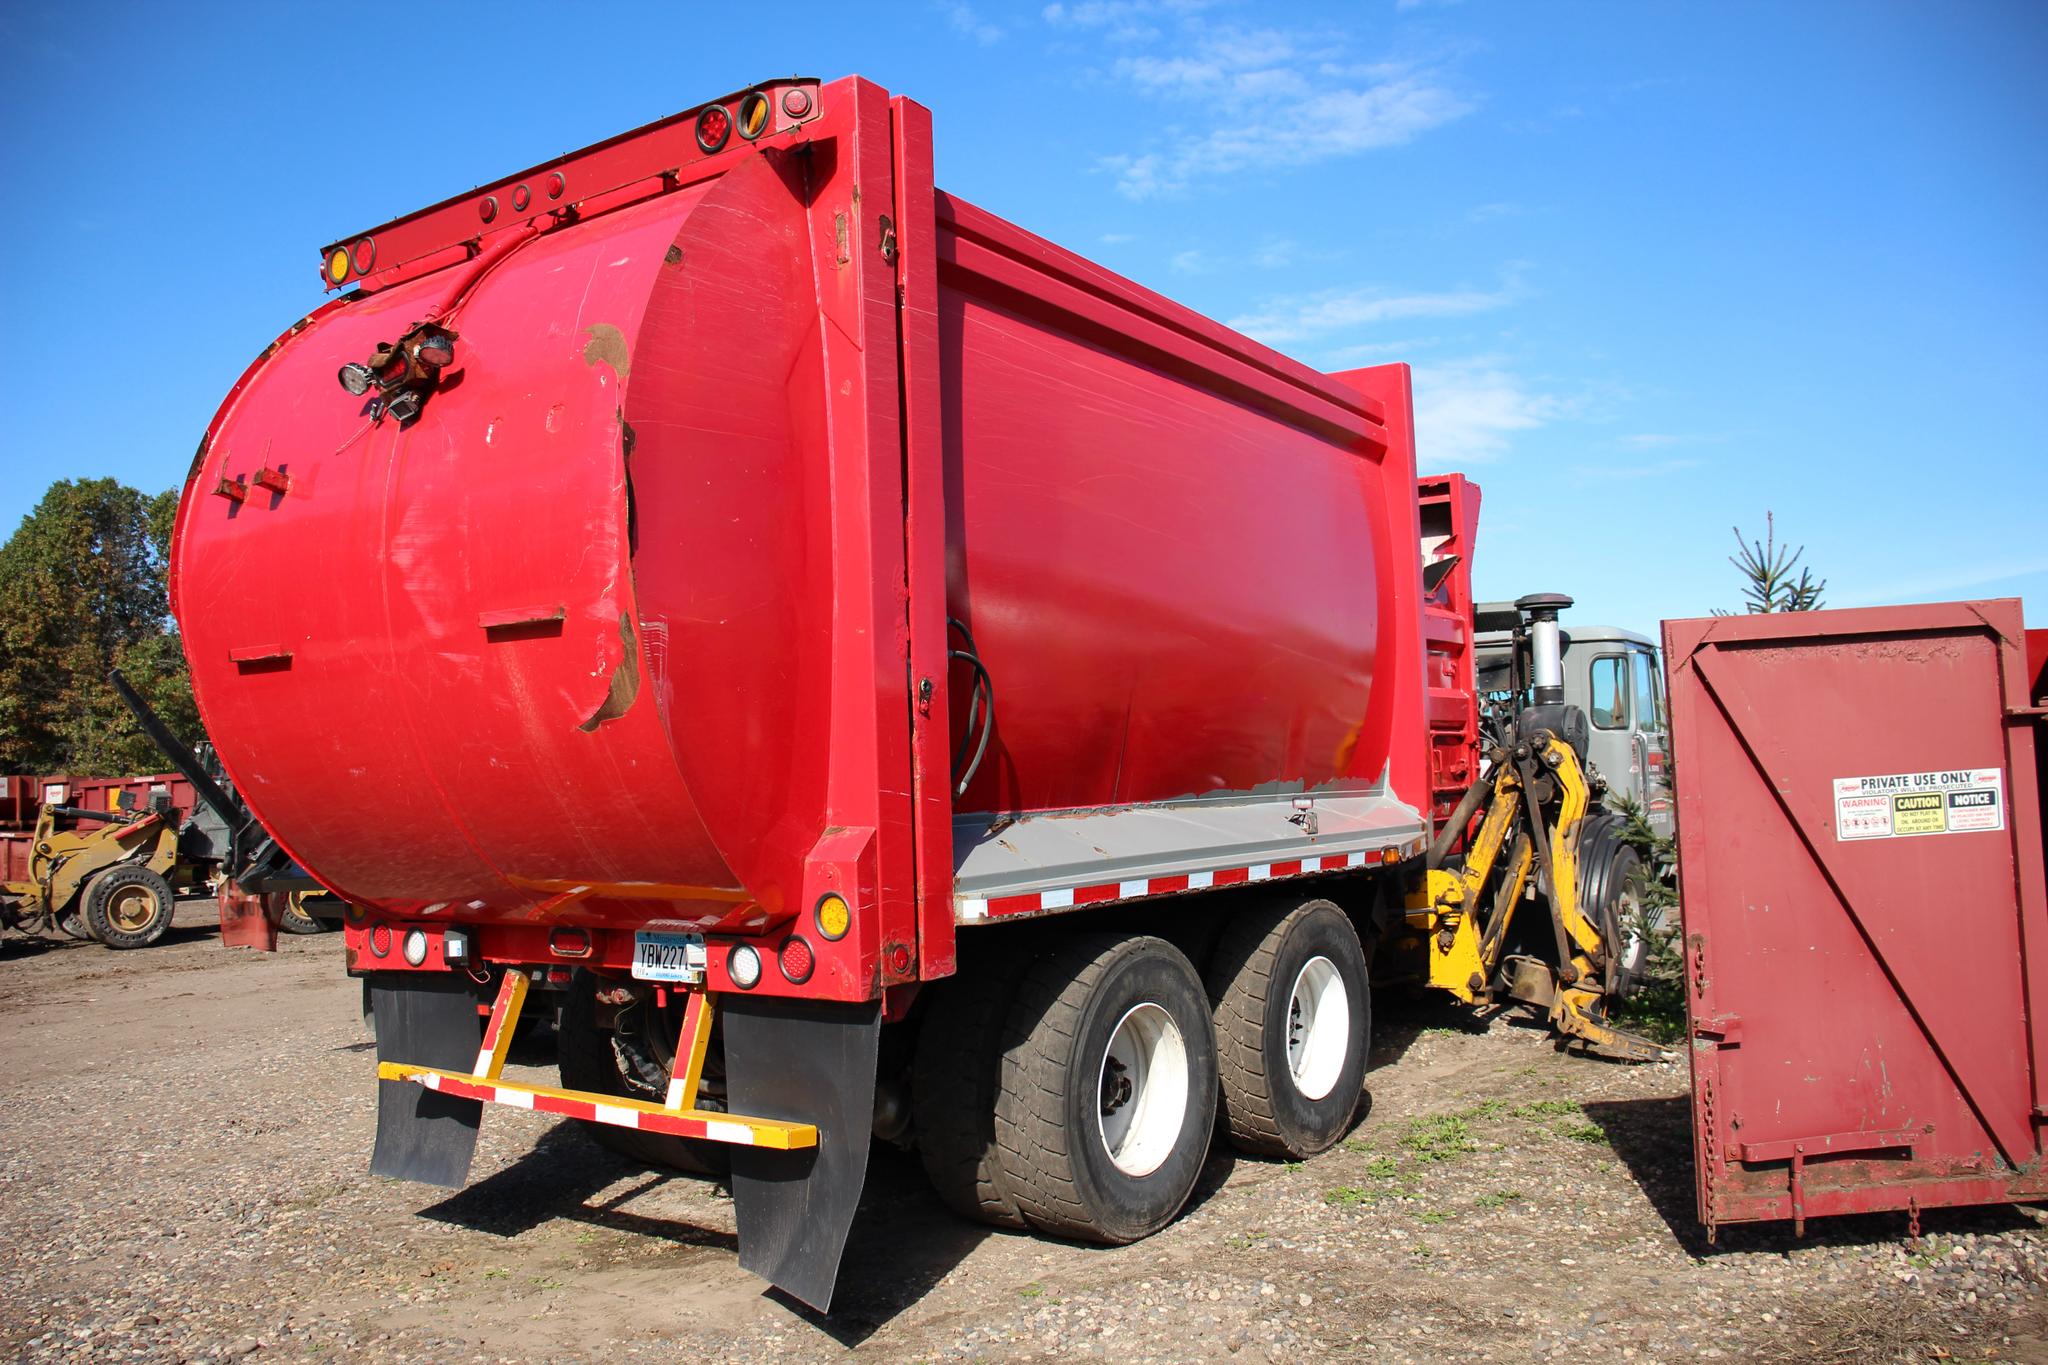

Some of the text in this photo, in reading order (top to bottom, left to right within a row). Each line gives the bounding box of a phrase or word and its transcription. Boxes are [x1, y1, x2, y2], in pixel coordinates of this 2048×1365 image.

[1861, 776, 1909, 789] PRIVATE
[1914, 774, 1936, 785] USE
[1941, 772, 1971, 784] ONLY
[1842, 798, 1887, 808] WARNING
[1898, 797, 1939, 809] CAUTION
[1955, 794, 1989, 805] NOTICE
